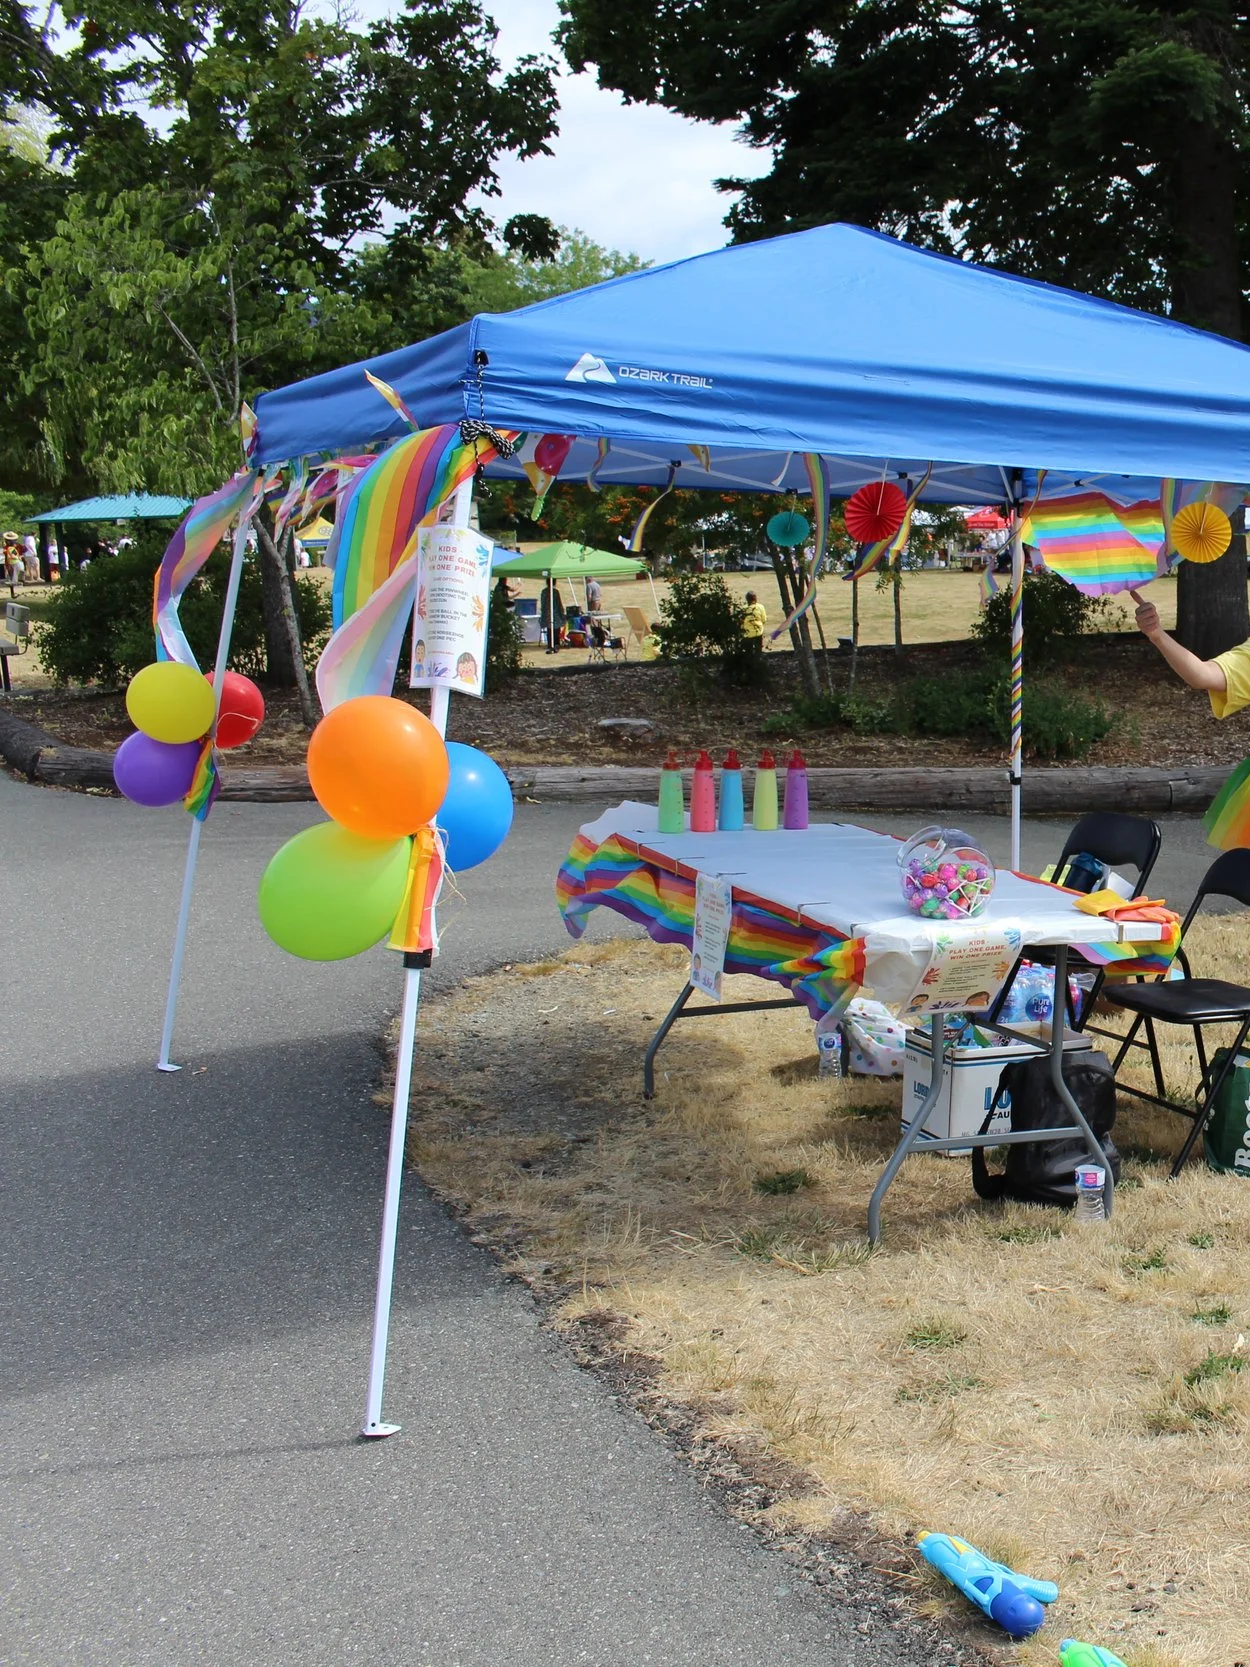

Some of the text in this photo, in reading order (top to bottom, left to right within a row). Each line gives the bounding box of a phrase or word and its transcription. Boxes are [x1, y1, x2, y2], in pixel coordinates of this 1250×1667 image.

[619, 366, 713, 389] OZARK TRAIL
[948, 947, 967, 955] PLAY
[1032, 998, 1050, 1006] Pure
[1034, 1005, 1048, 1014] Life
